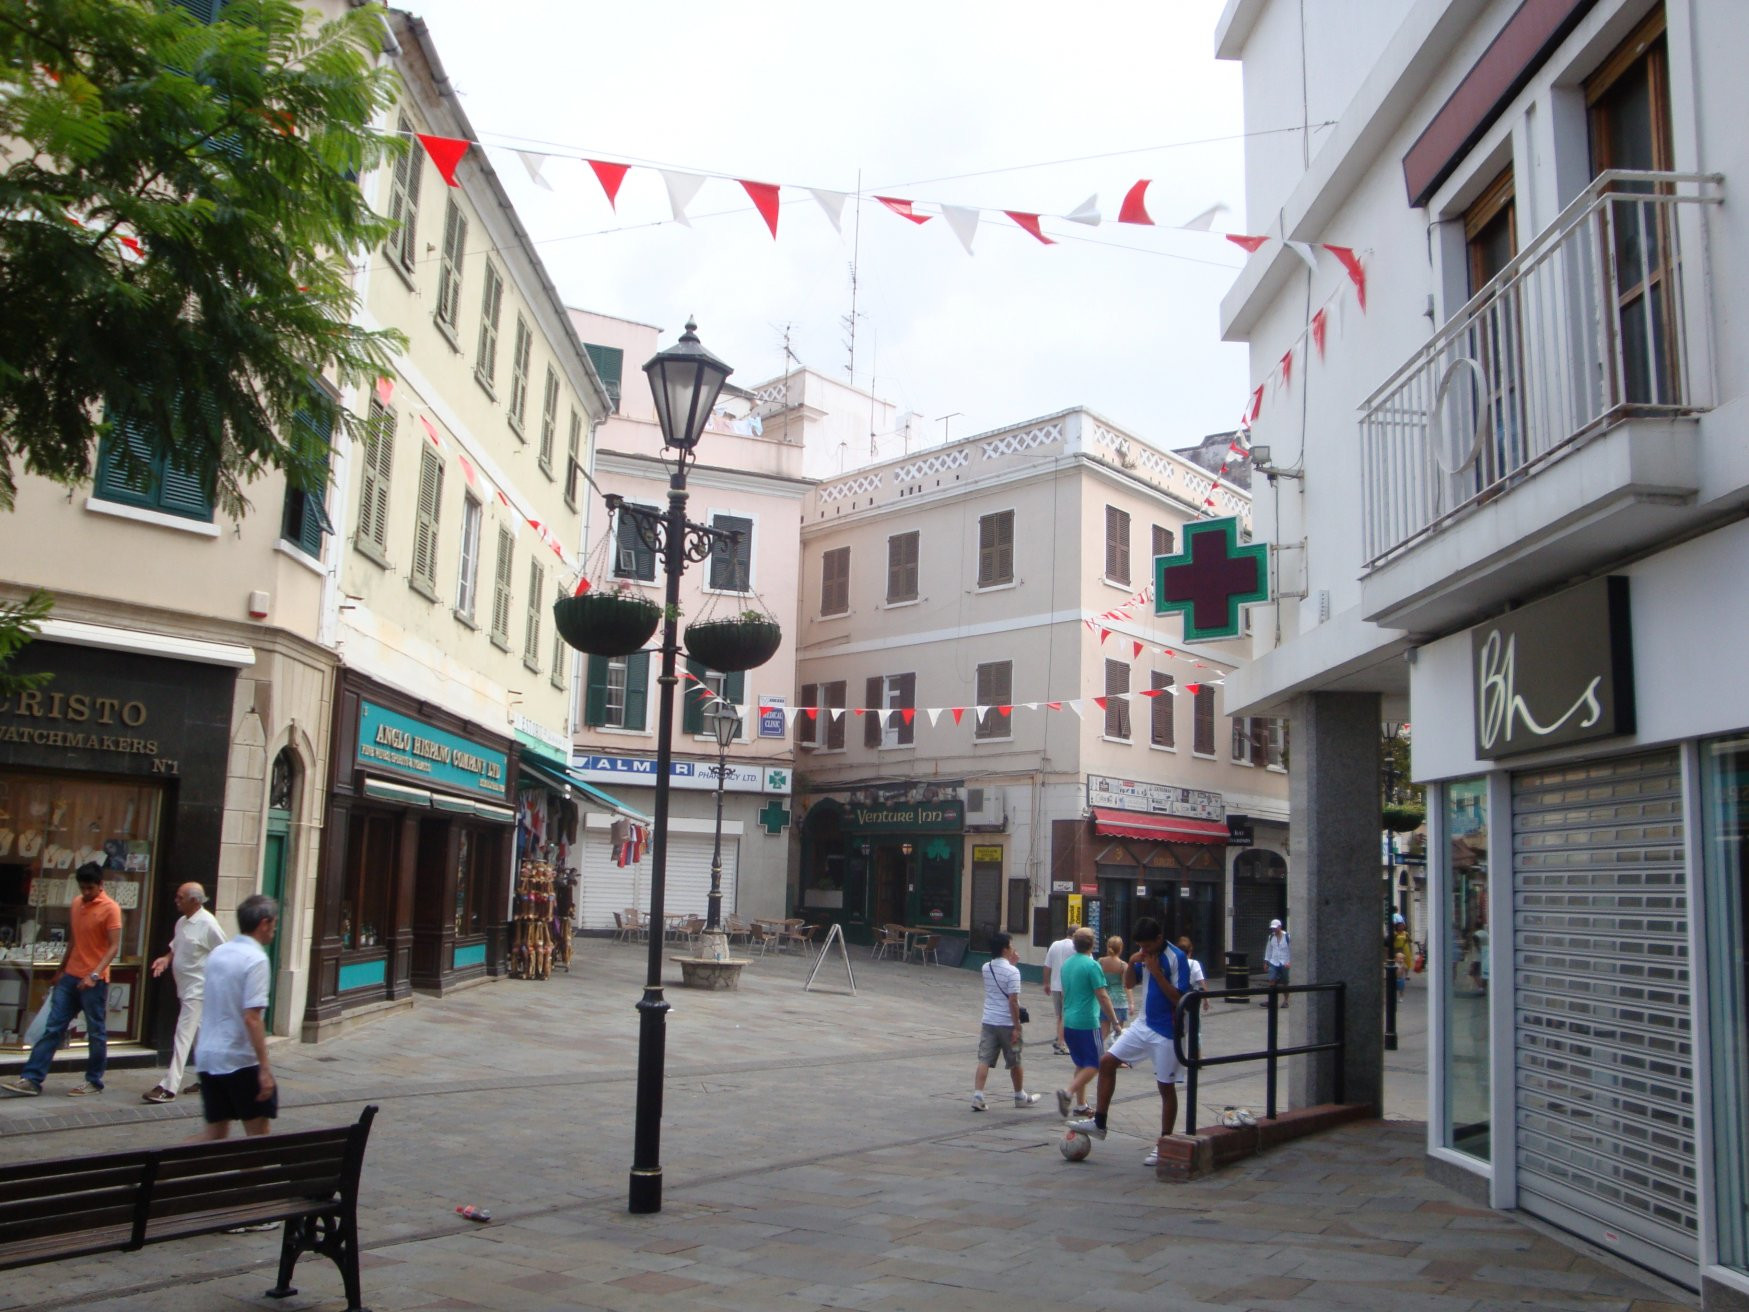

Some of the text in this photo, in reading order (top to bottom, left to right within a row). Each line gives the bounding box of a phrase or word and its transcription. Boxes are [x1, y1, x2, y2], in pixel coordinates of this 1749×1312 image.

[1481, 629, 1601, 749] Bhs
[763, 711, 784, 719] EDICAL
[764, 720, 780, 728] CLINIC
[376, 724, 411, 751] ANGLO
[413, 736, 450, 764] HISPANO
[453, 750, 486, 775] COMPANY
[487, 762, 501, 779] LTD
[597, 759, 688, 774] ALMR
[857, 808, 942, 824] Venture Inn
